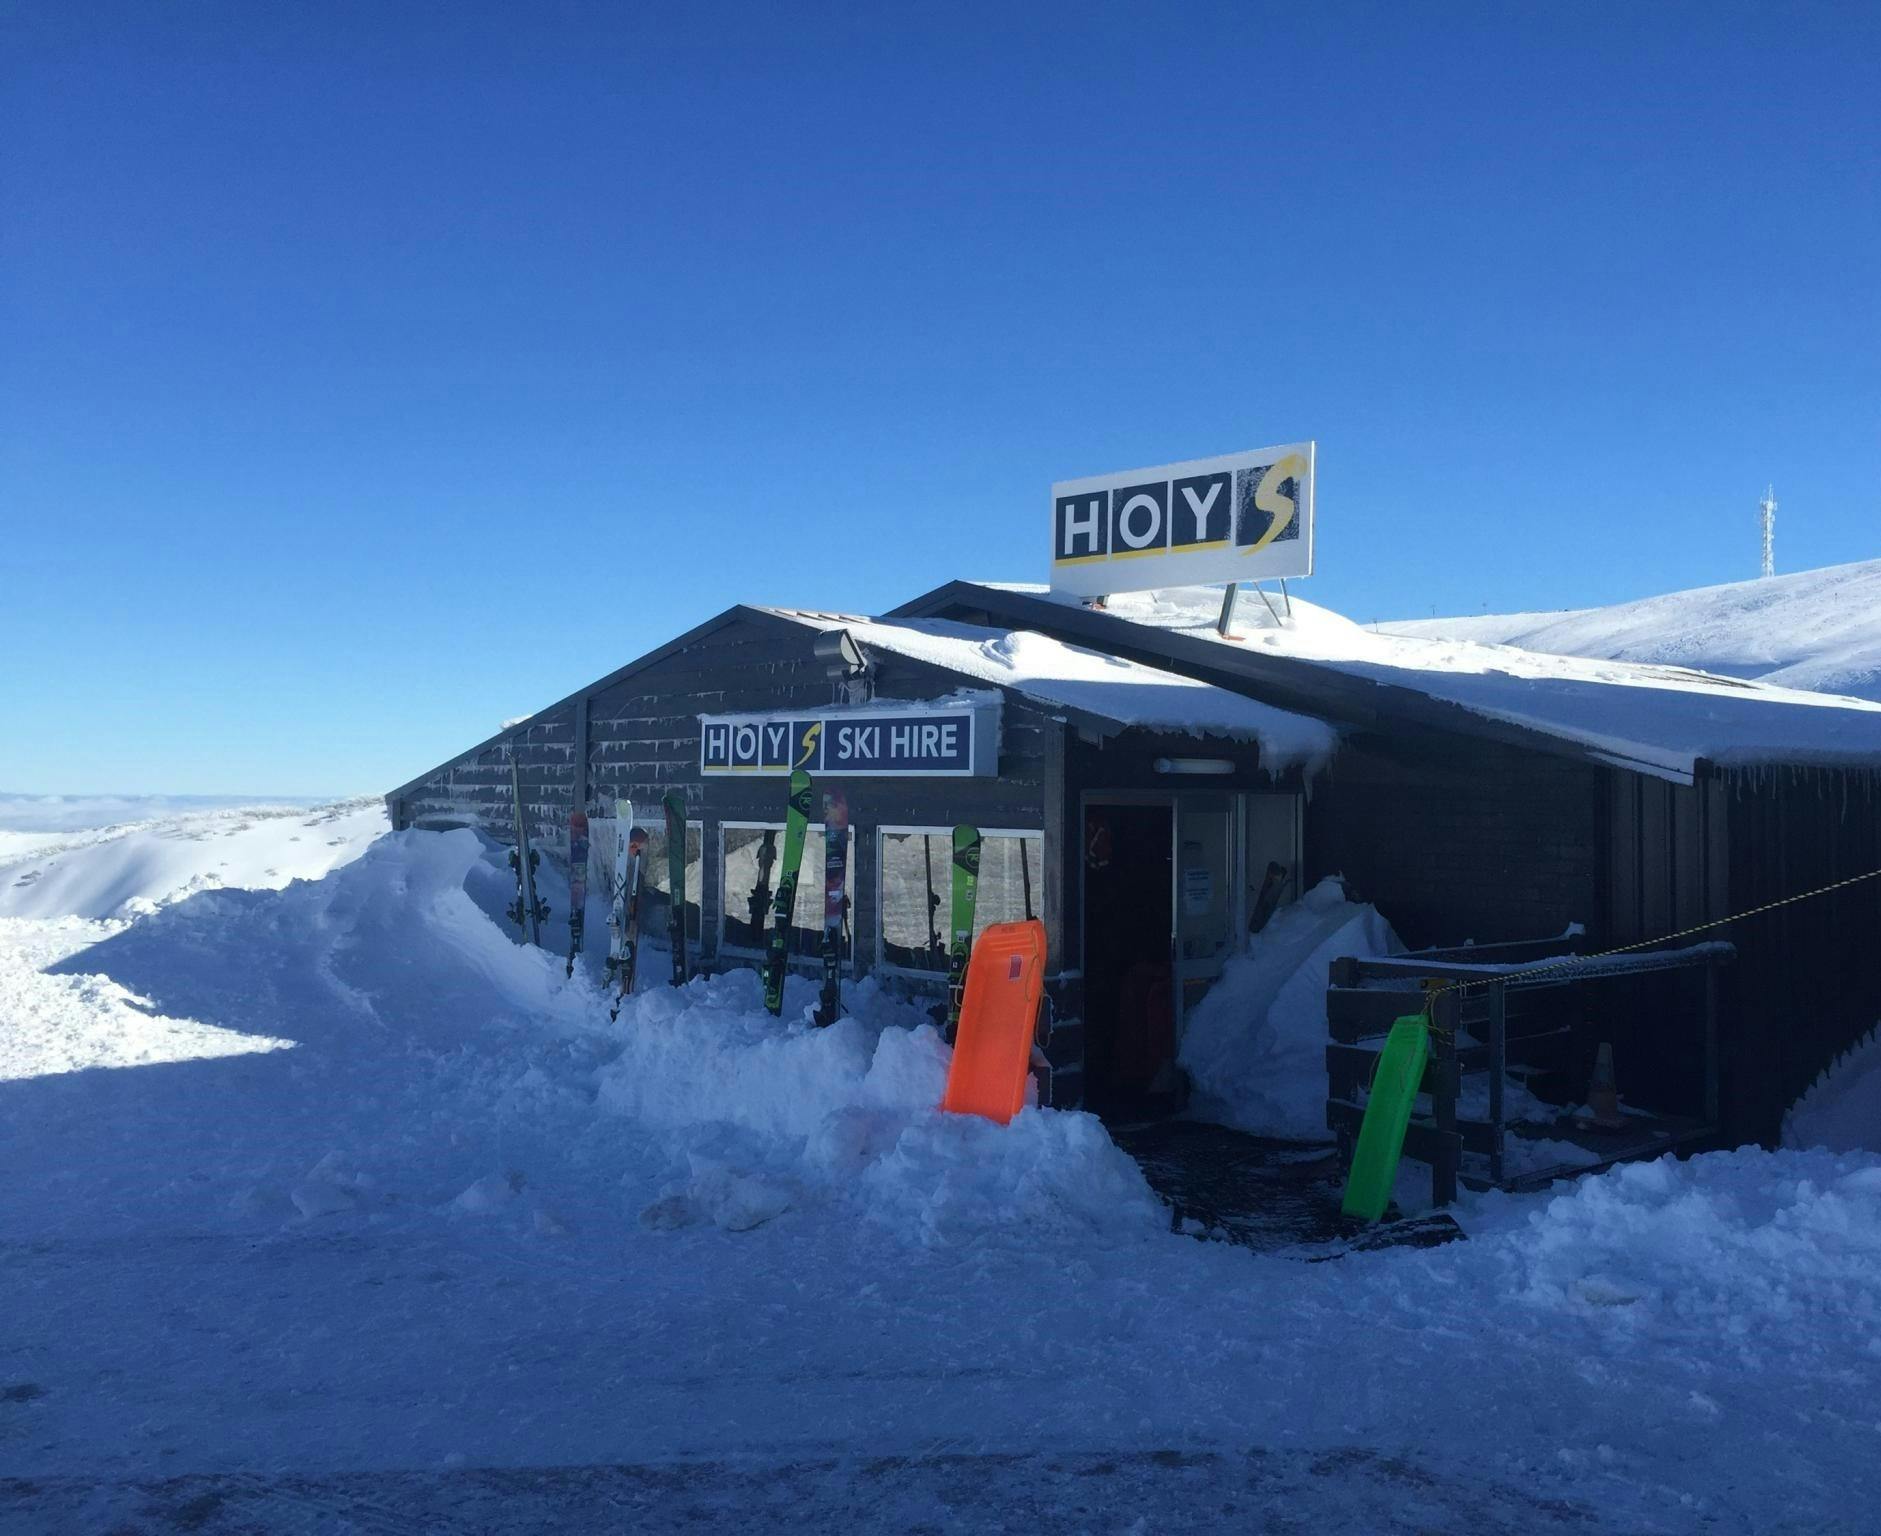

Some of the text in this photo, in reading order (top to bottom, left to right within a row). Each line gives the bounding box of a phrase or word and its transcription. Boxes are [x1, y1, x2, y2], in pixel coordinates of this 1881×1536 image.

[1064, 453, 1308, 557] HOYS
[708, 722, 958, 767] HOYS SKI HIRE
